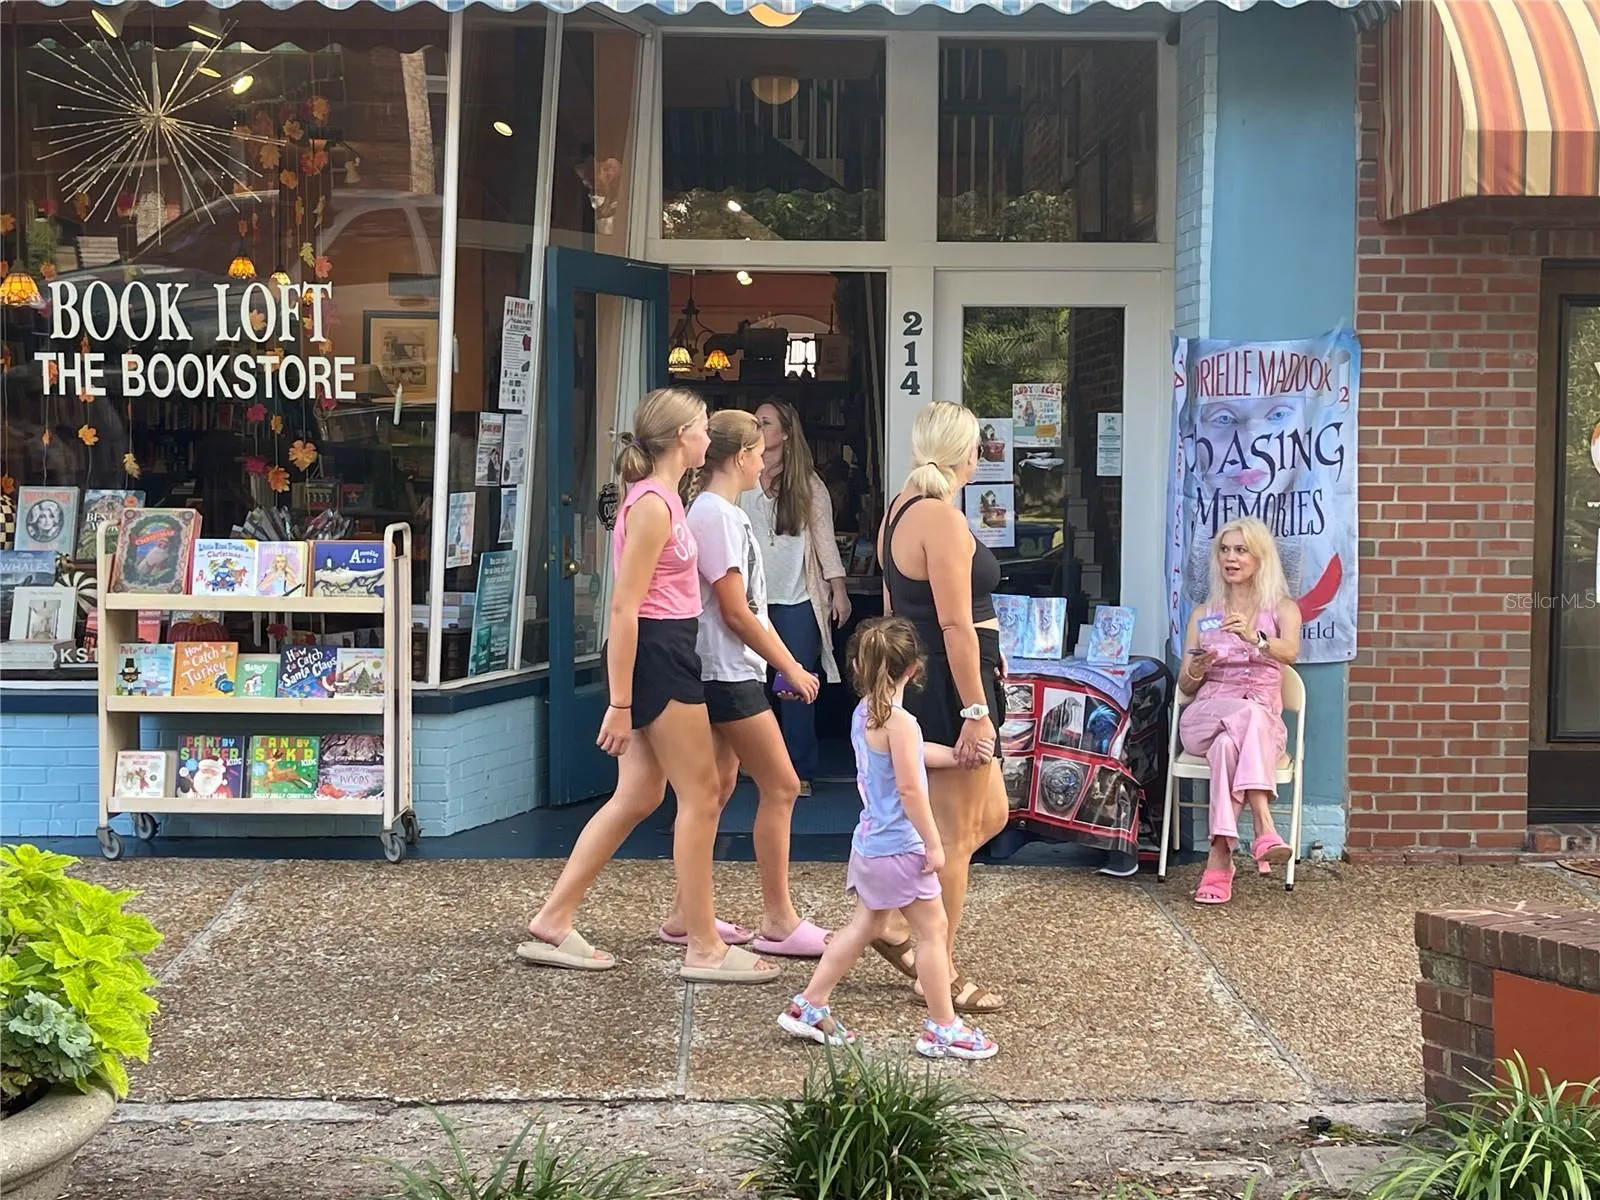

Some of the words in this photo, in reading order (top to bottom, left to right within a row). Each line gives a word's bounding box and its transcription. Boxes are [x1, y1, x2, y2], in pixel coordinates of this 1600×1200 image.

[48, 281, 193, 341] BOOK
[213, 282, 332, 343] LOFT
[900, 311, 922, 395] 214
[34, 352, 106, 396] THE
[121, 353, 356, 400] BOOKSTORE
[1258, 350, 1332, 396] MADDOX
[1339, 386, 1349, 403] 2
[1193, 487, 1325, 539] MEMORIES
[184, 645, 202, 657] How
[191, 647, 219, 667] Catch
[286, 647, 307, 663] How
[297, 648, 323, 668] Catch
[181, 661, 227, 687] Turkey
[282, 667, 310, 687] Santa
[312, 657, 337, 676] Claus
[222, 738, 235, 747] BY
